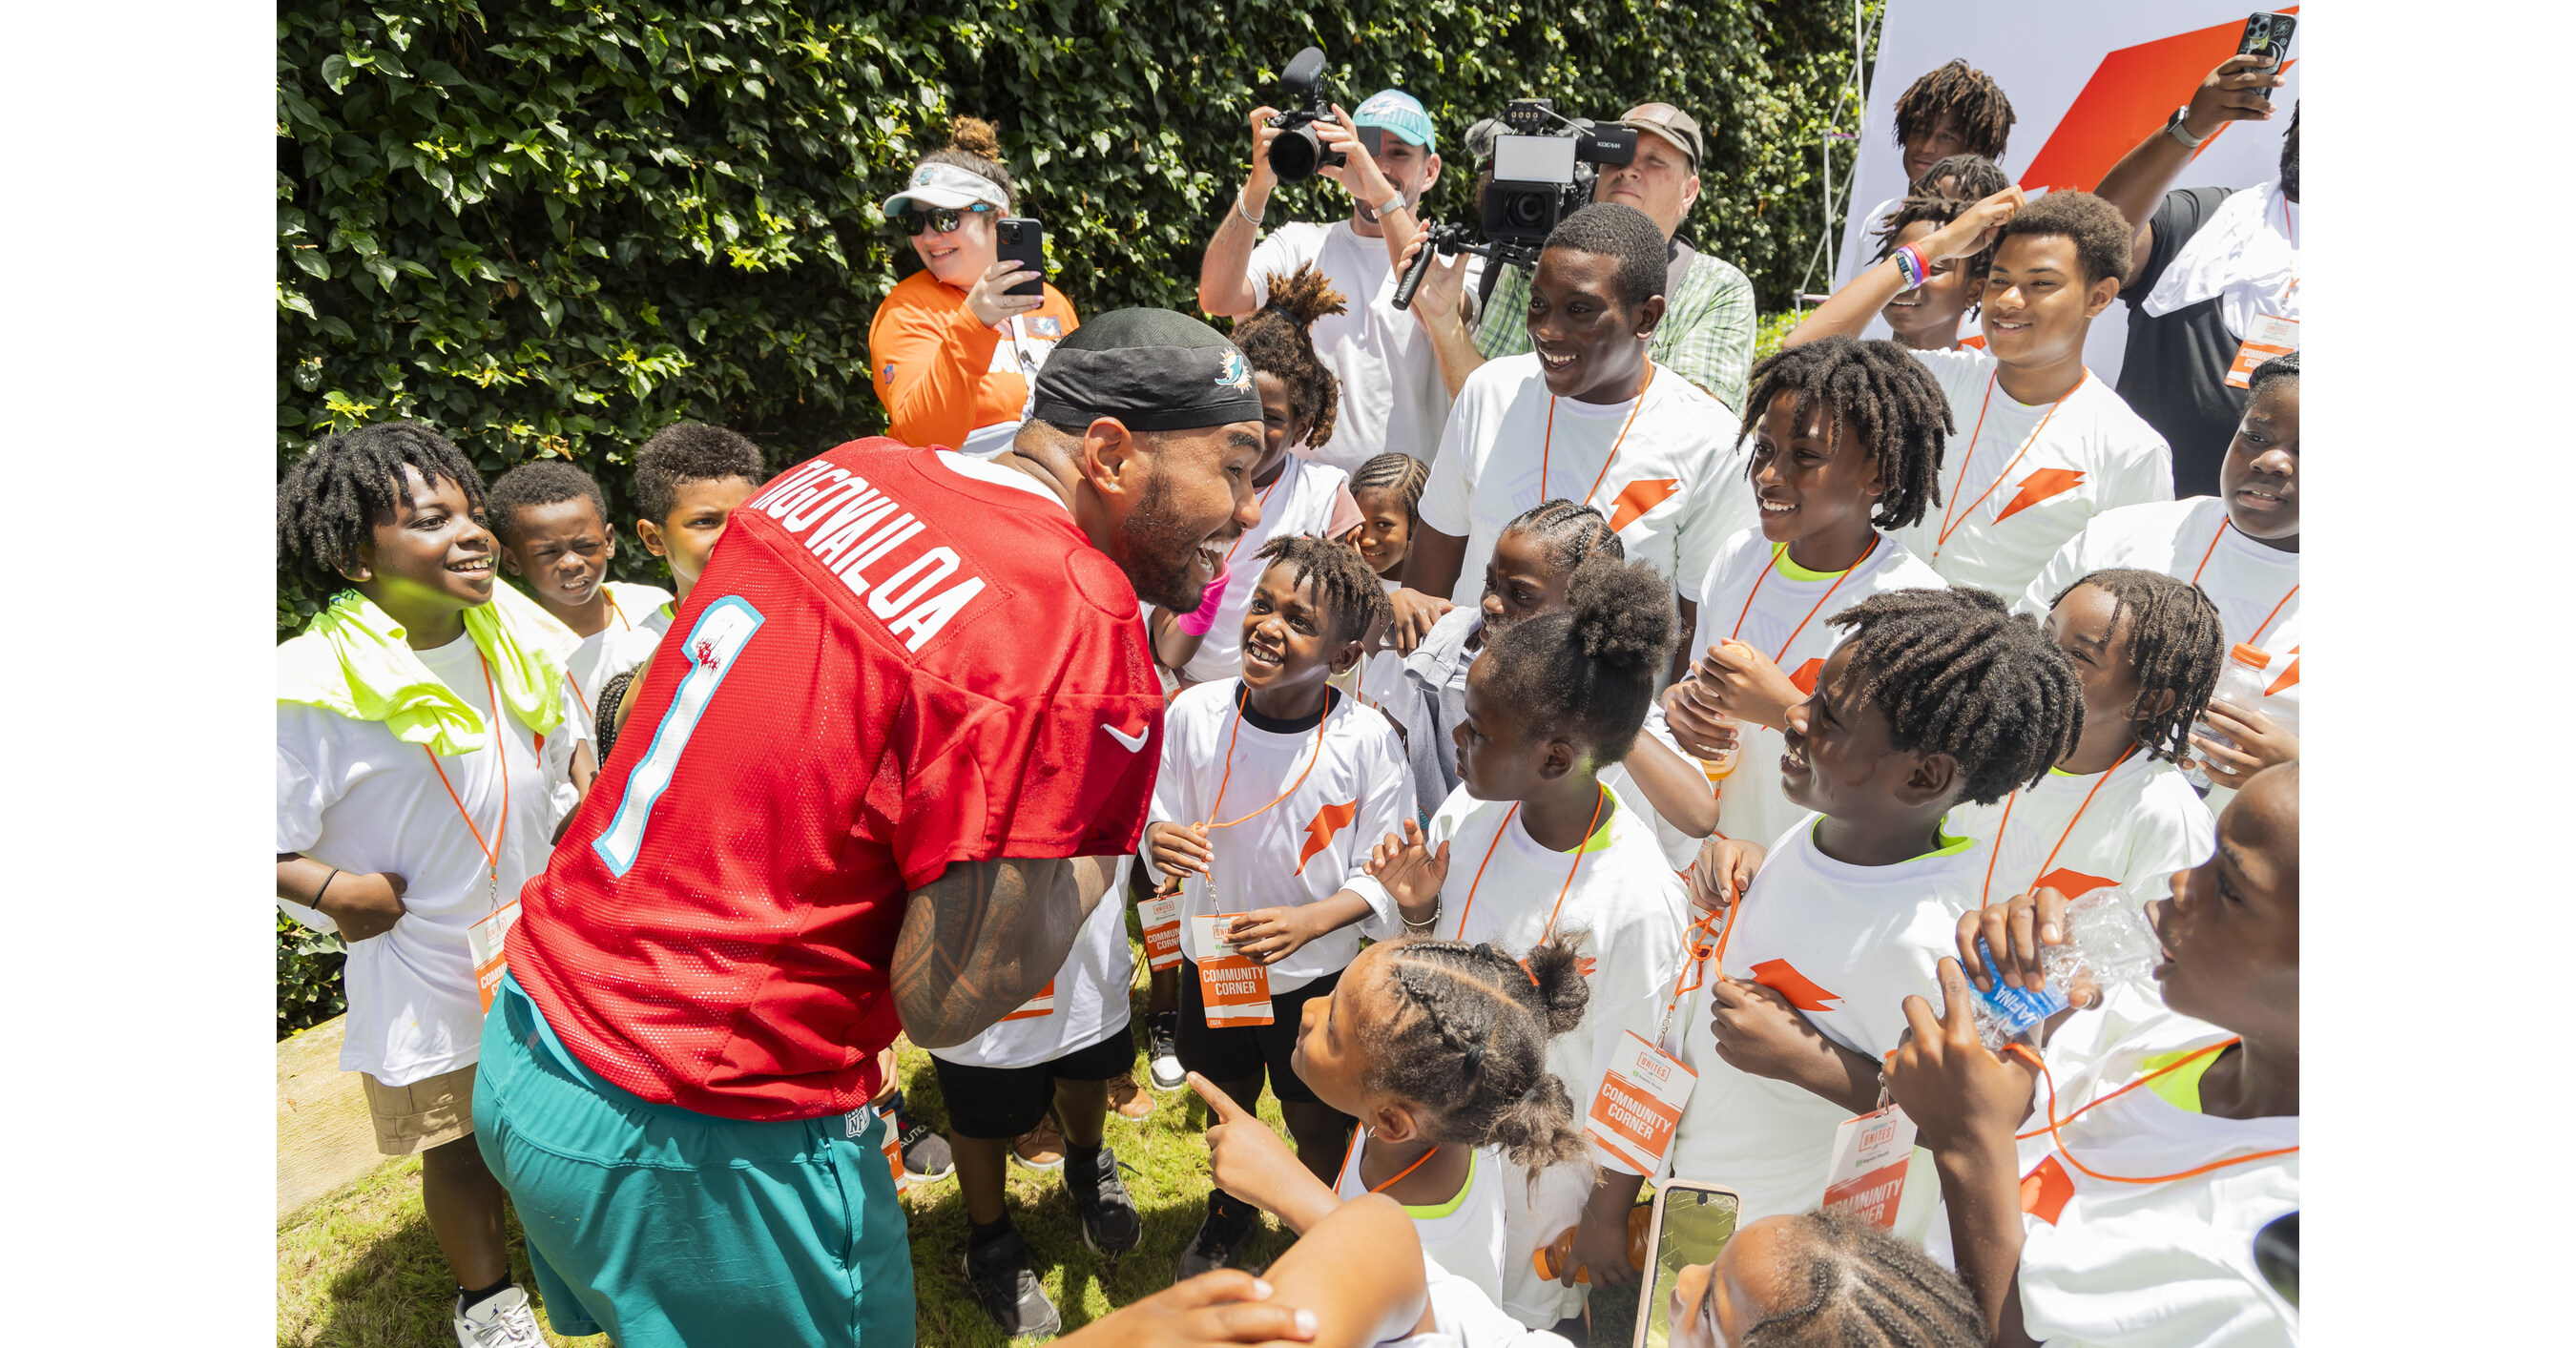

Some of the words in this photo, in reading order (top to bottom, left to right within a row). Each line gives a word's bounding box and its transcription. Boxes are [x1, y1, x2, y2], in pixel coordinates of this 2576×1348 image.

[592, 594, 766, 879] 1
[1147, 929, 1180, 944] COMMUN
[1202, 966, 1264, 984] COMMUNITY
[1215, 981, 1257, 996] CORNER
[1641, 1057, 1666, 1077] UNITES
[1602, 1083, 1672, 1133] COMMUNITY
[1608, 1103, 1654, 1141] CORNER
[900, 1125, 928, 1149] AUTIC
